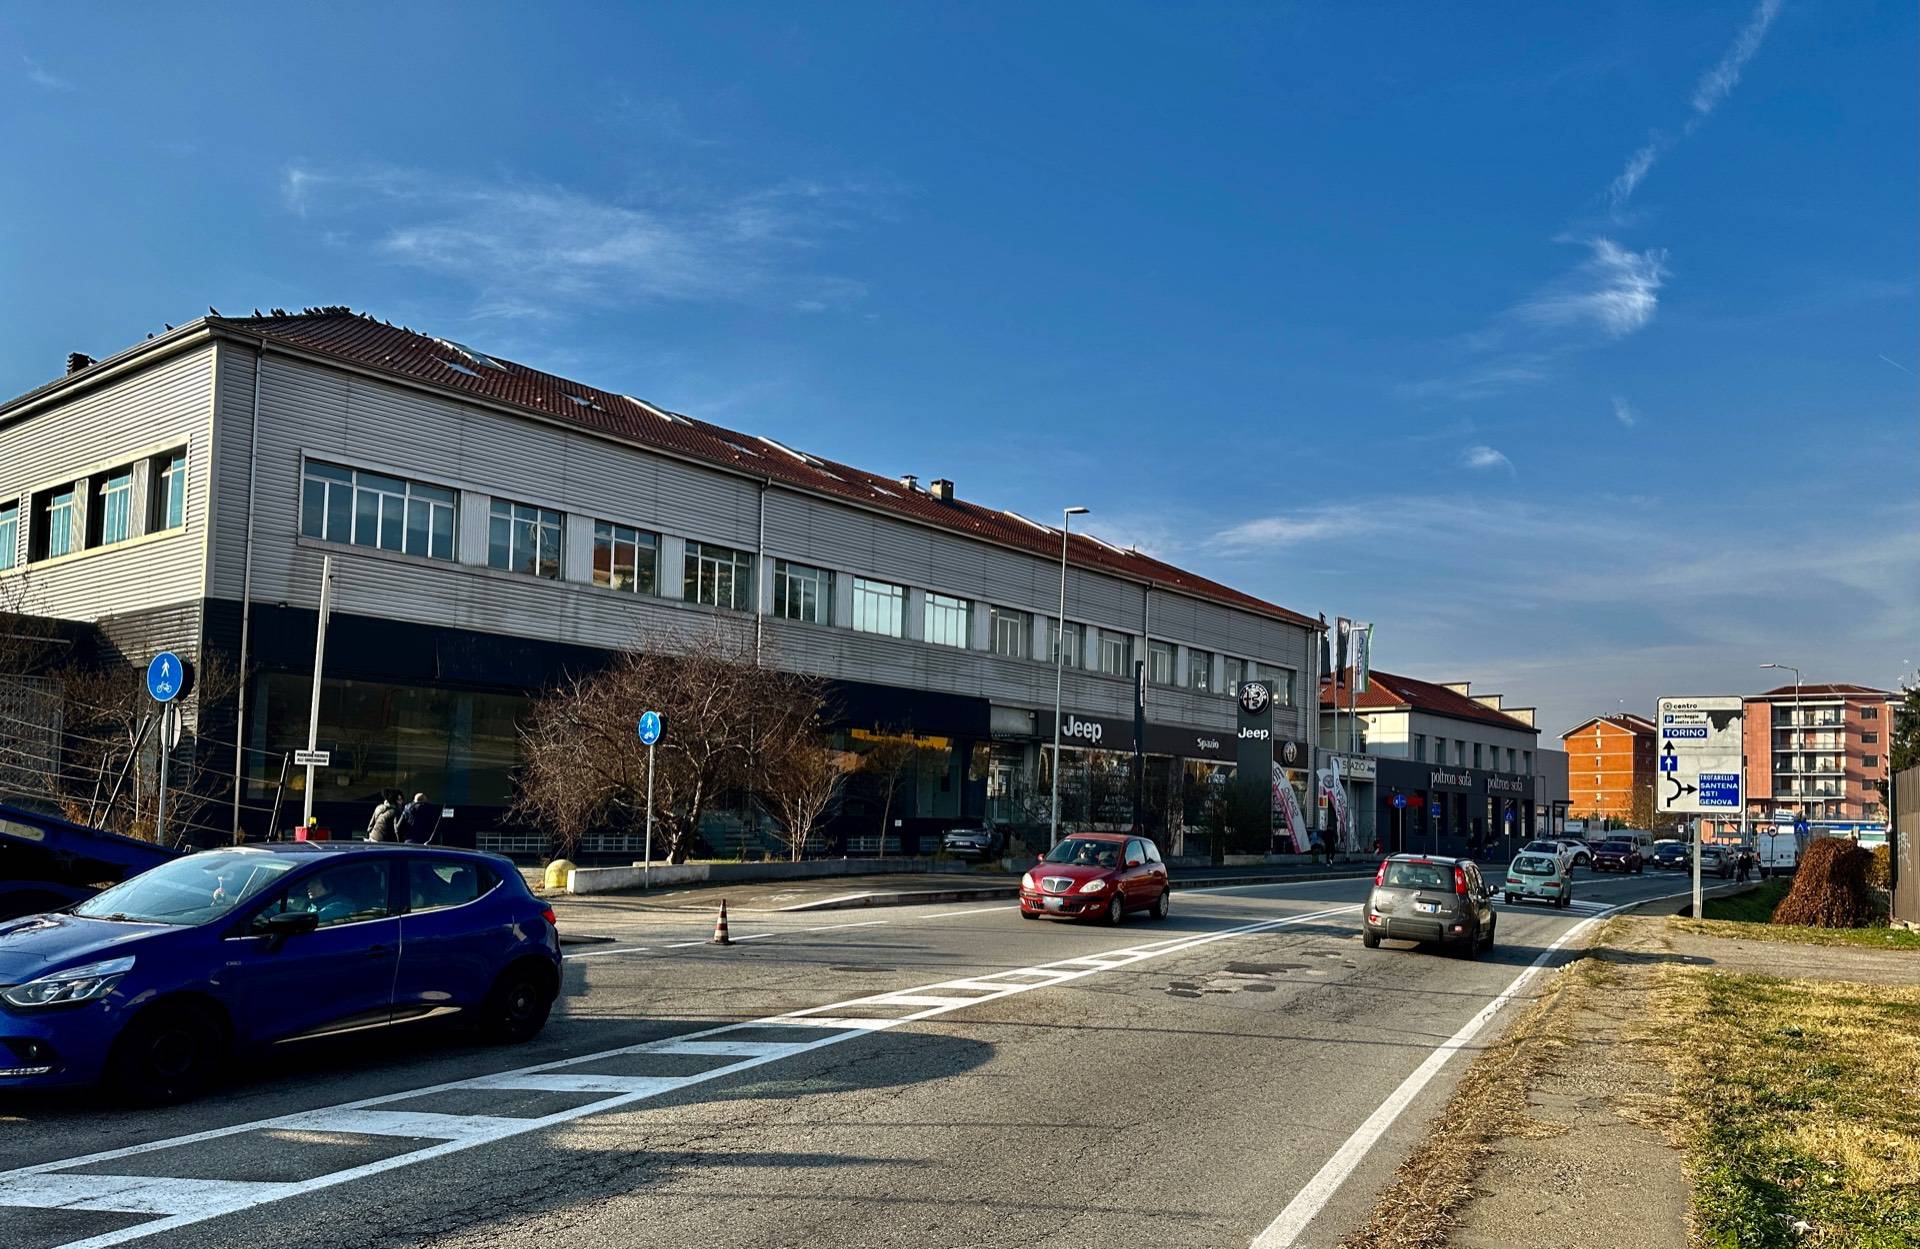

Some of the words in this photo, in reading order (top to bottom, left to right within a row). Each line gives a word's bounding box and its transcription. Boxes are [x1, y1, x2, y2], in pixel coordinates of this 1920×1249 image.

[1063, 714, 1102, 743] Jeep
[1238, 727, 1269, 740] Jeep
[1665, 728, 1706, 737] TORINO
[1197, 737, 1219, 750] Spazio
